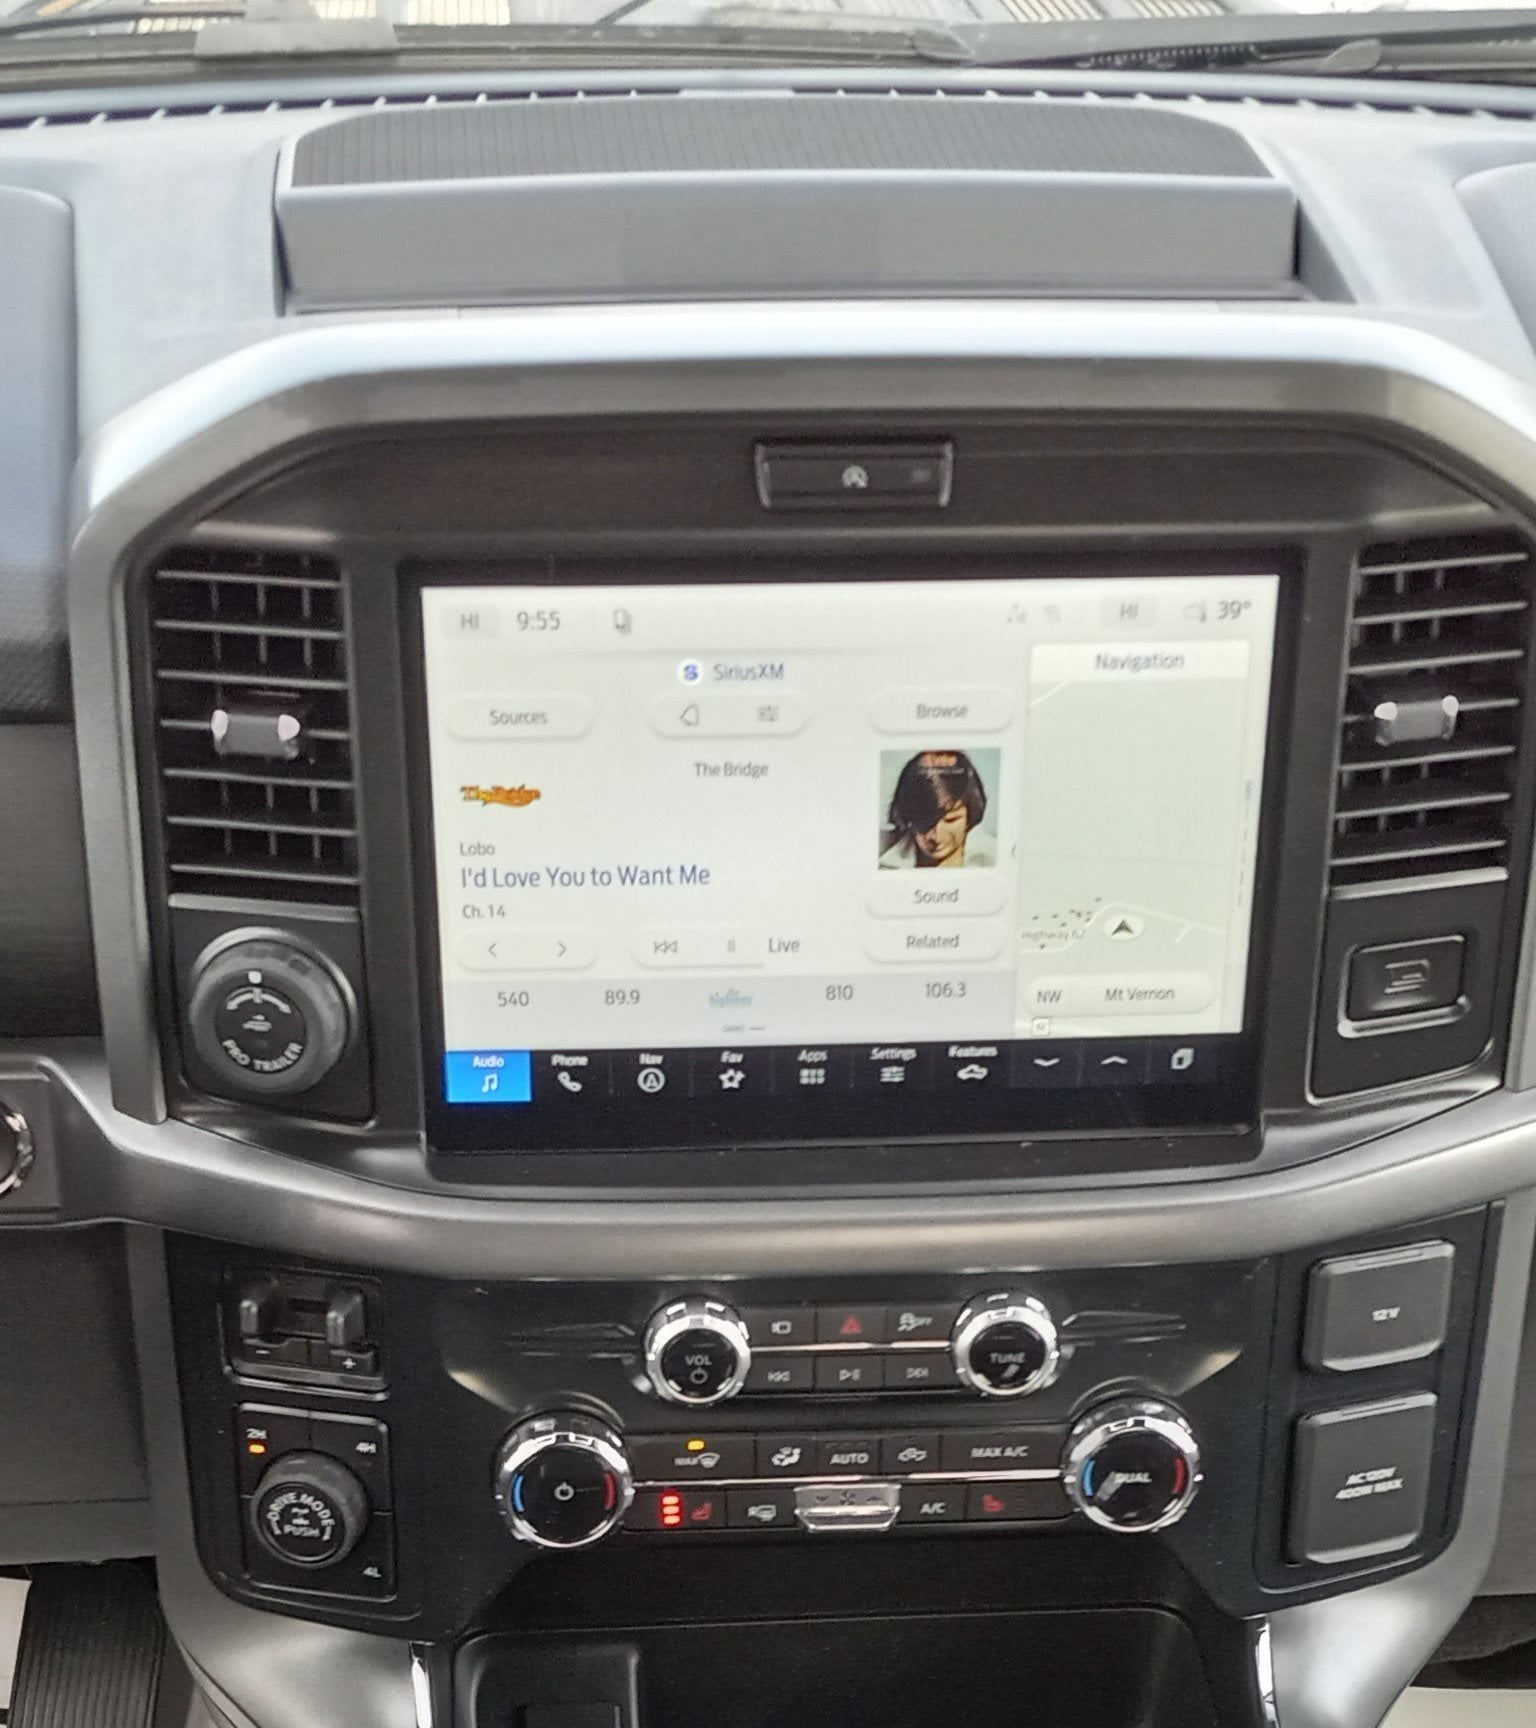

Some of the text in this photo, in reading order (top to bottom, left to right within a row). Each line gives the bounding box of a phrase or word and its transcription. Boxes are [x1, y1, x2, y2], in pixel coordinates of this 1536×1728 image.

[517, 609, 561, 631] 9:55
[1095, 652, 1185, 672] Navigation
[713, 662, 785, 681] SiriusXM
[489, 709, 548, 727] Sources
[916, 703, 968, 719] Browse
[694, 762, 769, 779] The Bridge
[460, 842, 496, 856] Lobo
[462, 865, 711, 888] I'd Love You to Want Me
[913, 889, 959, 905] Sound
[488, 904, 507, 919] 14
[768, 937, 800, 954] Live
[906, 934, 959, 950] Related
[604, 989, 641, 1006] 89.9
[825, 985, 854, 1002] 810
[925, 982, 966, 1000] 106.3
[1037, 989, 1063, 1004] NW
[1104, 987, 1175, 1001] Mt Vernon
[497, 992, 530, 1007] 540
[721, 1051, 744, 1063] Fav
[797, 1049, 828, 1063] Apps
[870, 1047, 917, 1062] Settings
[948, 1045, 998, 1058] Features
[473, 1055, 505, 1068] Audio
[551, 1054, 588, 1067] Phone
[639, 1053, 663, 1066] Nav
[685, 1354, 712, 1367] VOL
[989, 1352, 1025, 1363] TUNE
[829, 1452, 869, 1465] AUTO
[971, 1445, 1029, 1459] MAX A/C
[1116, 1472, 1152, 1483] DUAL
[300, 1493, 336, 1527] MODE
[920, 1501, 946, 1515] A/C
